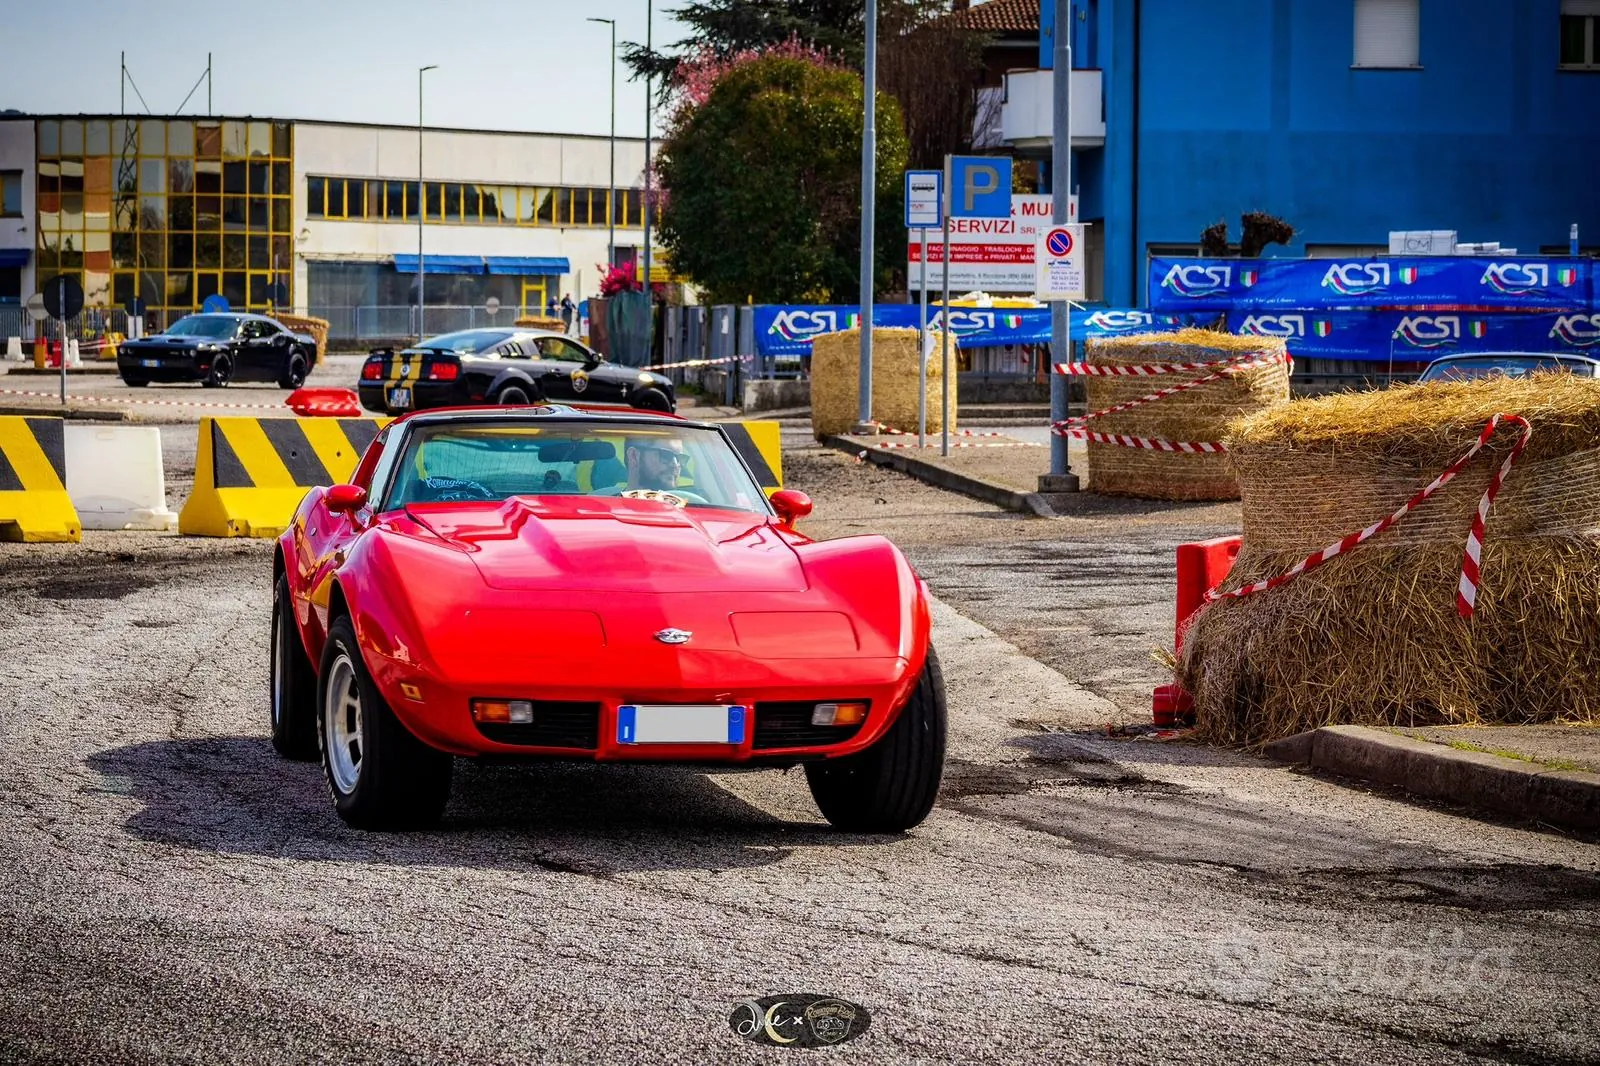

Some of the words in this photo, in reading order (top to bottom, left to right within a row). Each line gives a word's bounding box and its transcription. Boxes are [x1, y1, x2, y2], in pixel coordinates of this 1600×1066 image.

[964, 165, 999, 211] P
[1021, 202, 1075, 217] MUI
[949, 219, 1015, 234] SERVIZI
[1161, 264, 1231, 288] ACSI
[1321, 263, 1390, 287] ACSI
[1480, 262, 1548, 287] ACSI
[767, 310, 837, 335] ACSI
[1084, 310, 1153, 327] ACSI
[1238, 315, 1305, 338] ACSI
[1392, 315, 1461, 339] ACSI
